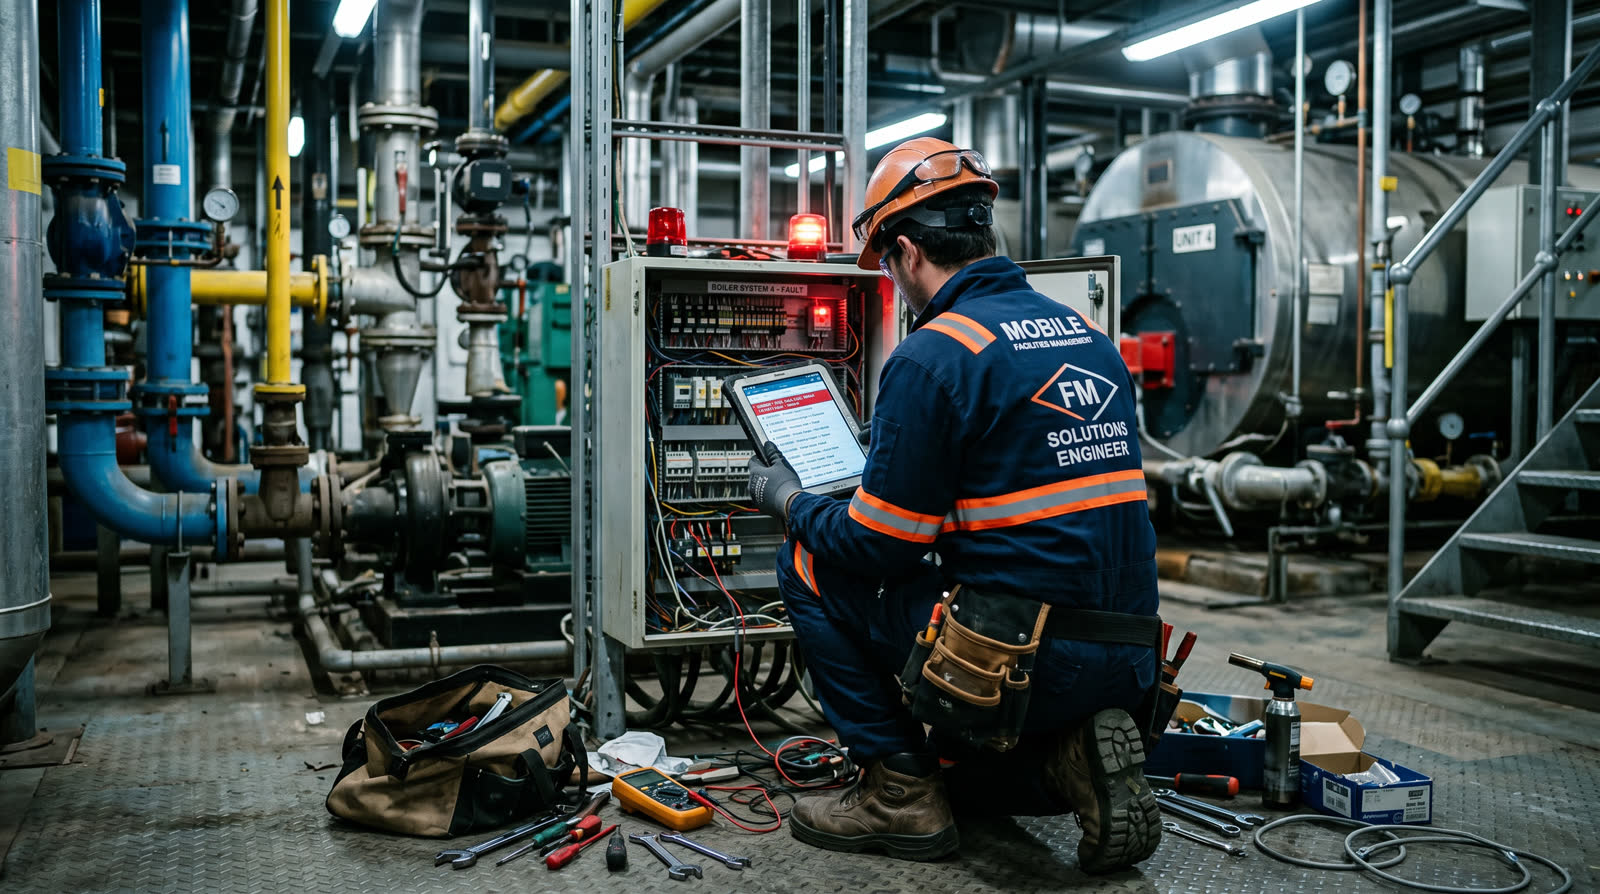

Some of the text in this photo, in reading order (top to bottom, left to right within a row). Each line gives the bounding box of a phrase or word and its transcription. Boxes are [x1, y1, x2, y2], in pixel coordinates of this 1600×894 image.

[1175, 229, 1212, 247] UNIT 4
[711, 283, 739, 292] BOILER
[740, 284, 769, 293] SYSTEM
[770, 285, 775, 293] 4
[781, 286, 804, 294] FAULT
[1000, 316, 1087, 341] MOBILE
[1013, 336, 1093, 351] FACILITIES MANAGEMENT
[1058, 378, 1101, 409] FM
[1047, 421, 1128, 448] SOLUTIONS
[1056, 441, 1130, 467] ENGINEER
